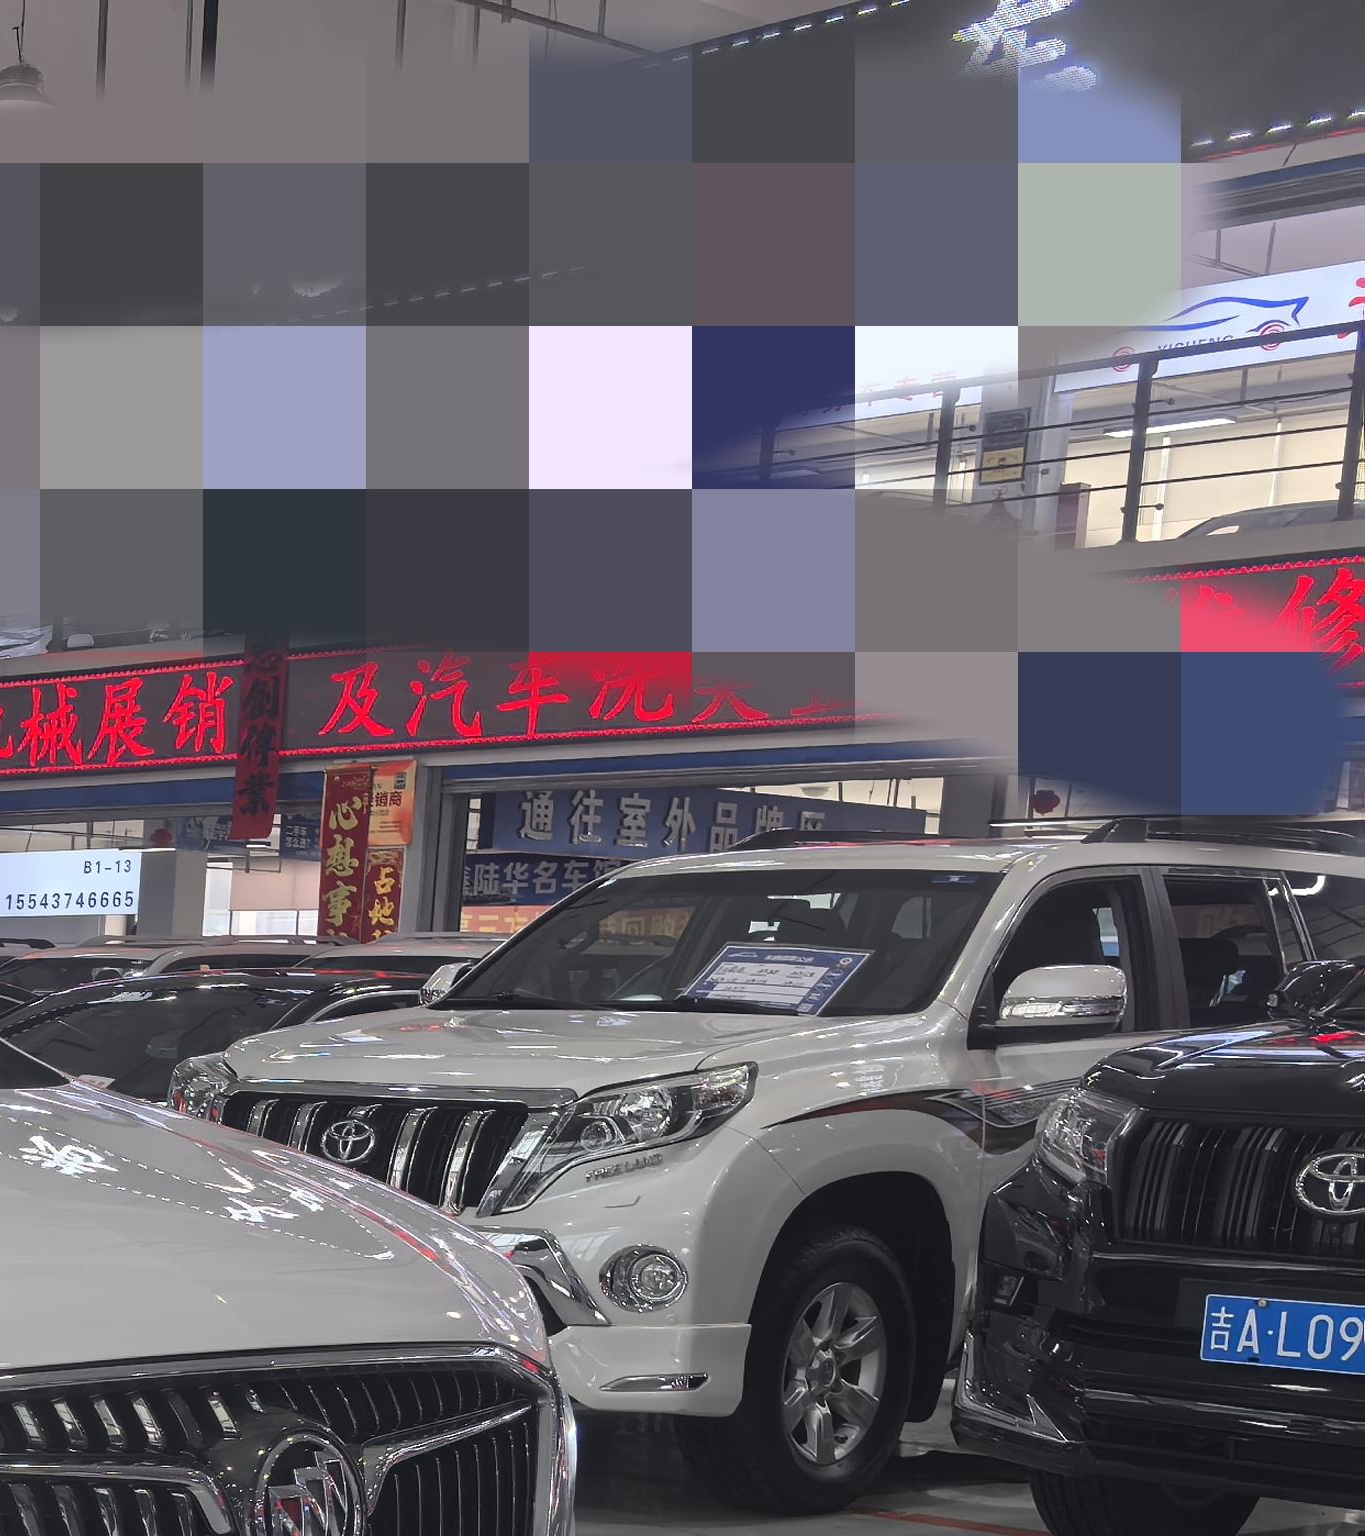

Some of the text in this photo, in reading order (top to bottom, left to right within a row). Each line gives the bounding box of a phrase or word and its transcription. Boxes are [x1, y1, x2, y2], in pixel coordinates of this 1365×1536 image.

[83, 859, 132, 875] B1-13
[5, 890, 135, 912] 15543746665
[1210, 1306, 1365, 1362] 吉A·L09
